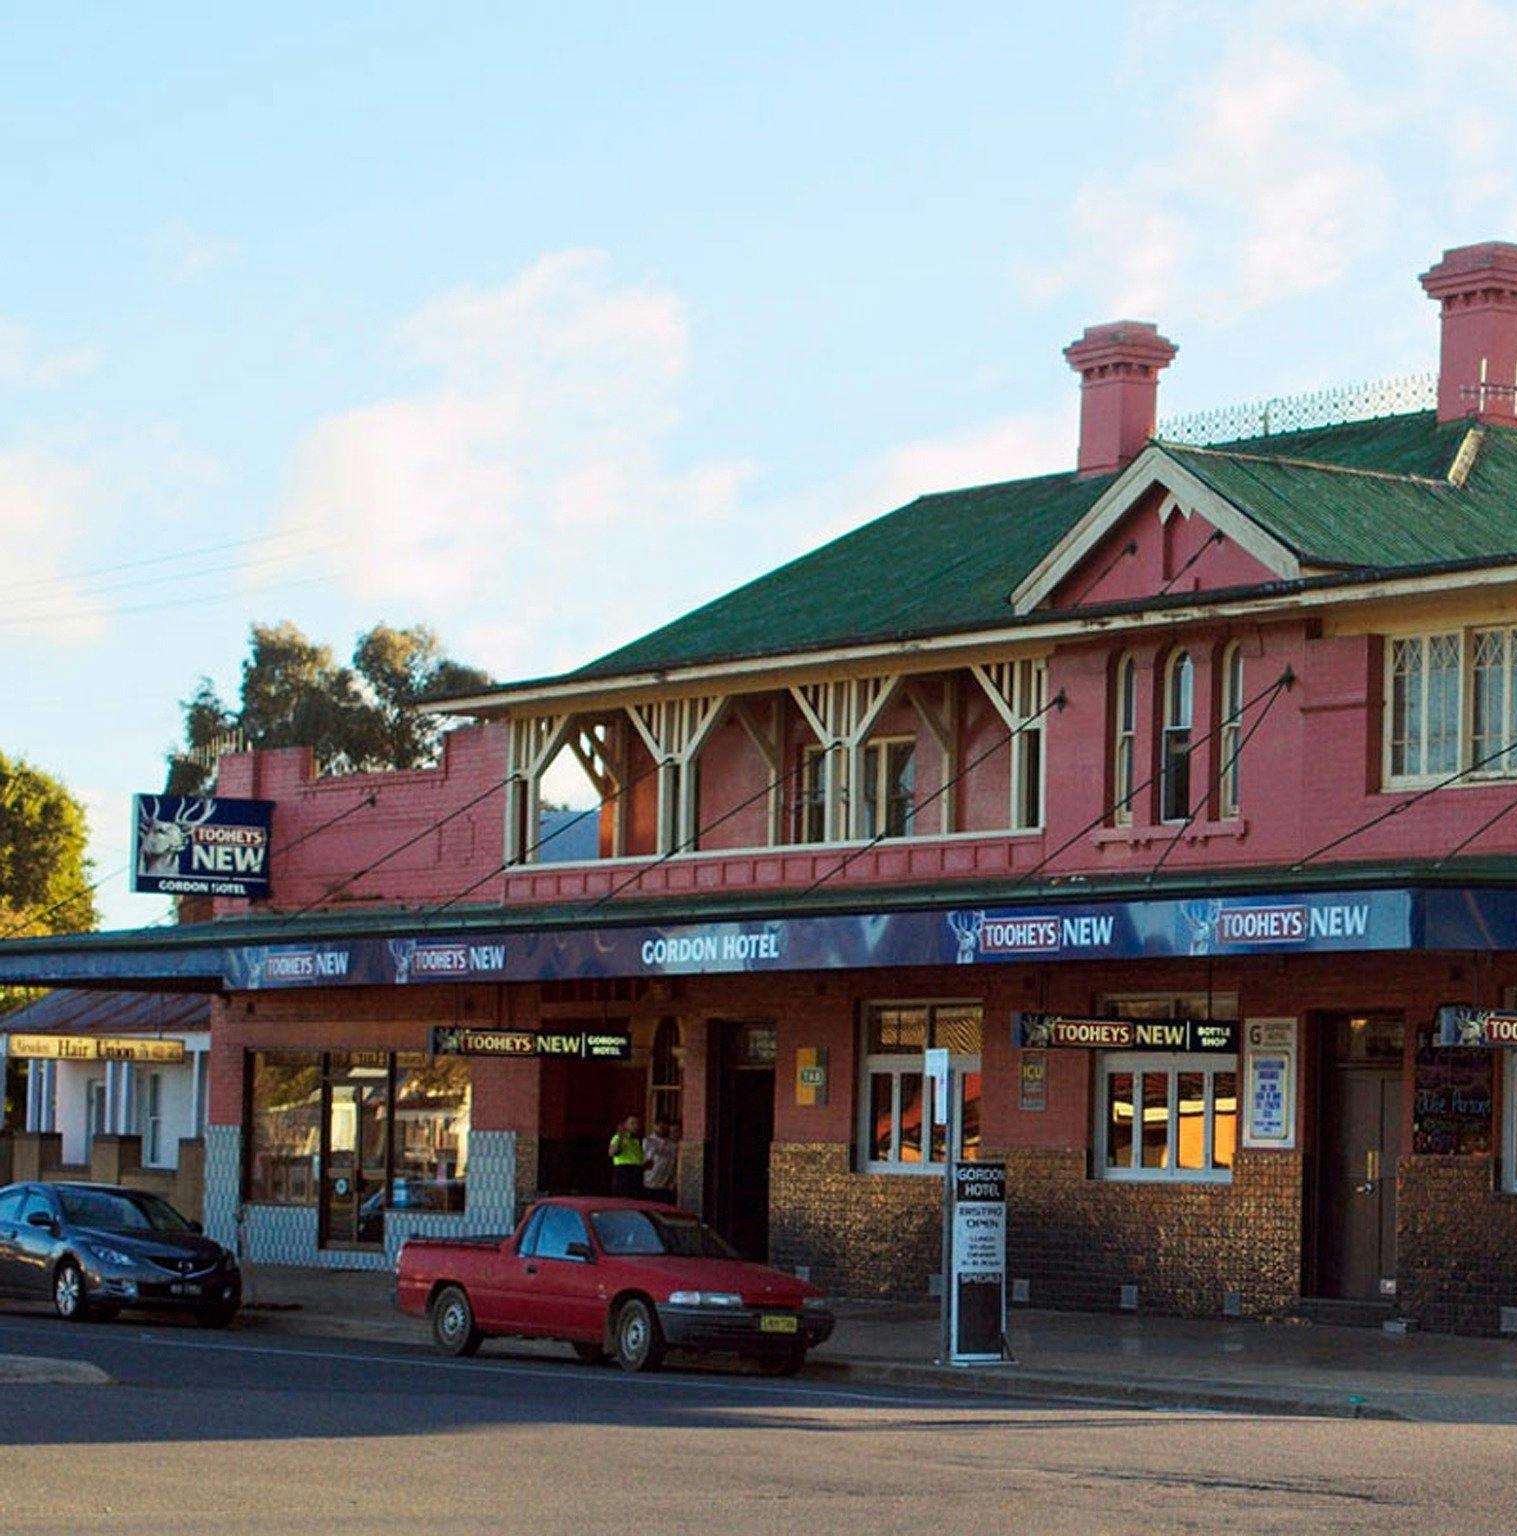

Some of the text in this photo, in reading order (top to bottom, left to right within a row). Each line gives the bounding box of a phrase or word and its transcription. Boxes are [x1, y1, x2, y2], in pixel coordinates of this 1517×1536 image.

[199, 828, 263, 844] TOOHEYS
[191, 845, 265, 873] NEW
[158, 880, 208, 892] GORDON
[1221, 906, 1369, 937] TOOHEYS NEW
[984, 916, 1114, 947] TOOHEYS NEW
[415, 945, 506, 971] TOOHEYS NEW
[641, 934, 780, 964] GORDON HOTEL
[267, 952, 349, 976] TOOHEYS NEW
[587, 1036, 627, 1045] GORDON
[1058, 1025, 1185, 1045] TOOHEYS NEW
[1198, 1026, 1231, 1037] BOTTLE
[57, 1039, 89, 1058] Hair
[467, 1035, 581, 1053] TOOHEYS NEW
[592, 1046, 621, 1055] HOTEL
[1202, 1037, 1227, 1047] SHOP
[965, 1183, 1000, 1197] HOTEL
